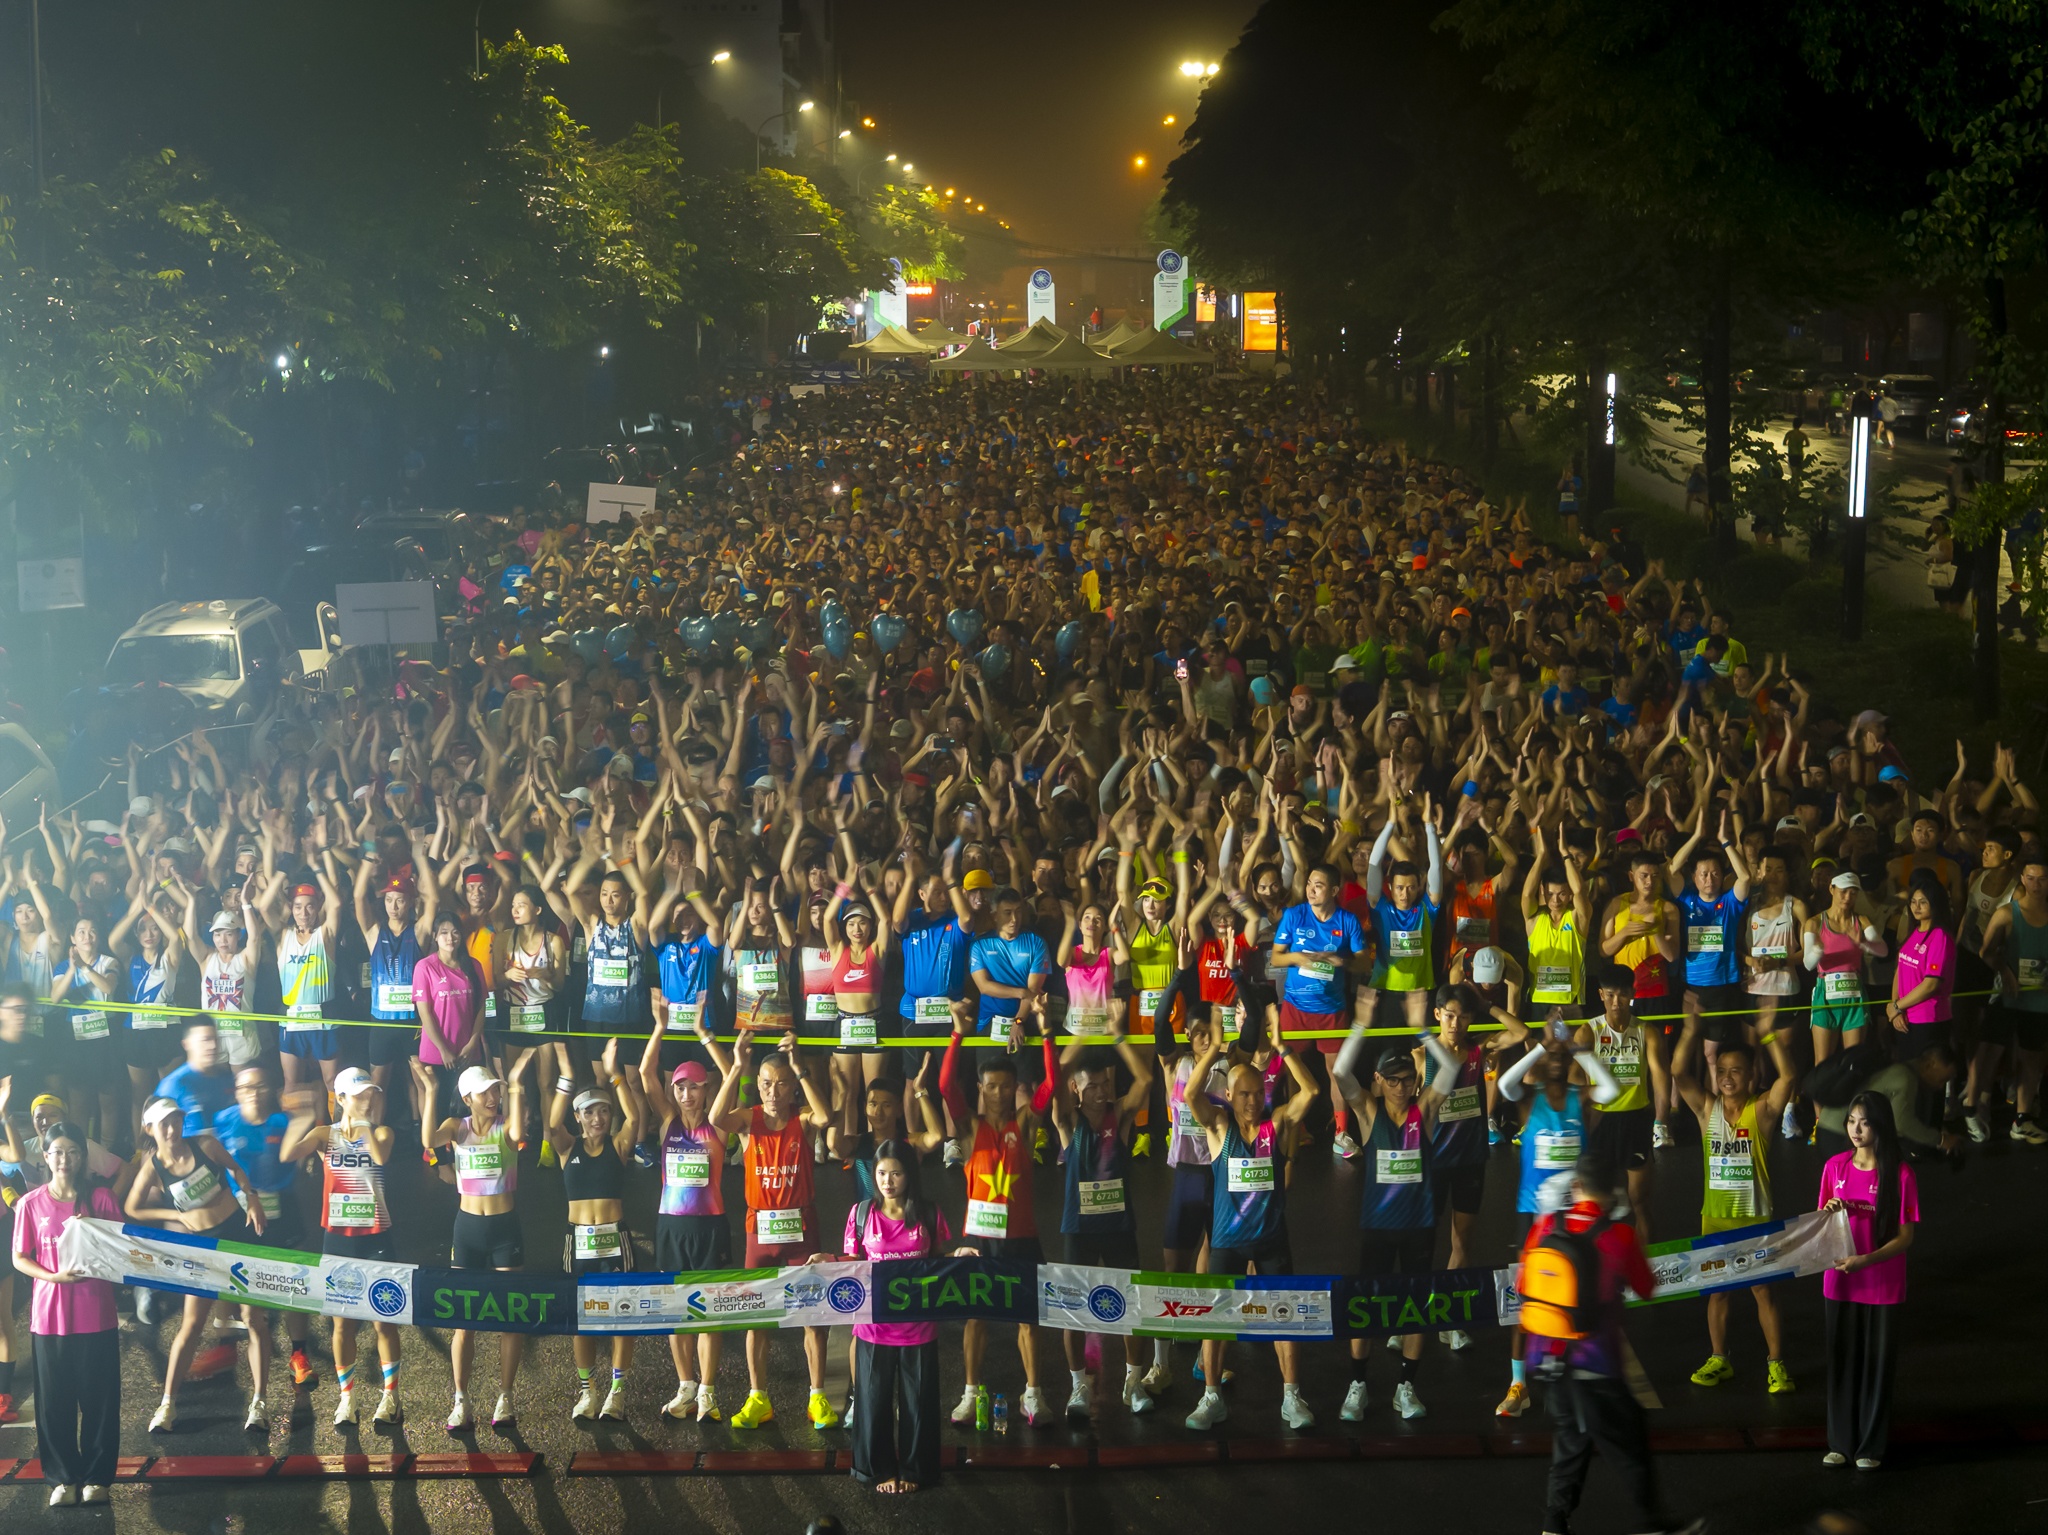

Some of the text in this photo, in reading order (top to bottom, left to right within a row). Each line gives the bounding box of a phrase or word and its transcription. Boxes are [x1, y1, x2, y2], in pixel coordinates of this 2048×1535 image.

[1700, 934, 1722, 942] 62704
[604, 968, 625, 976] 68241
[755, 972, 776, 981] 63865
[1209, 969, 1229, 978] RU
[1548, 974, 1570, 982] 69895
[928, 1005, 950, 1013] 63769
[853, 1027, 876, 1035] 68002
[1613, 1065, 1638, 1074] 65562
[1453, 1097, 1477, 1108] 65533
[1711, 1140, 1753, 1155] PR SPORT
[330, 1153, 373, 1168] USA
[679, 1165, 705, 1175] 67174
[755, 1164, 800, 1176] BAC NINH
[1244, 1169, 1269, 1178] 61738
[1724, 1167, 1752, 1177] 69406
[762, 1176, 794, 1189] RUN
[1096, 1190, 1120, 1201] 67218
[345, 1205, 373, 1214] 65564
[772, 1220, 800, 1230] 63424
[590, 1235, 615, 1246] 67451
[255, 1271, 305, 1286] standard
[255, 1280, 308, 1296] chartered
[888, 1272, 1021, 1311] START
[713, 1292, 763, 1304] standard
[434, 1287, 556, 1323] START
[713, 1300, 766, 1312] chartered
[1155, 1301, 1214, 1318] XTEP
[1347, 1289, 1480, 1329] START
